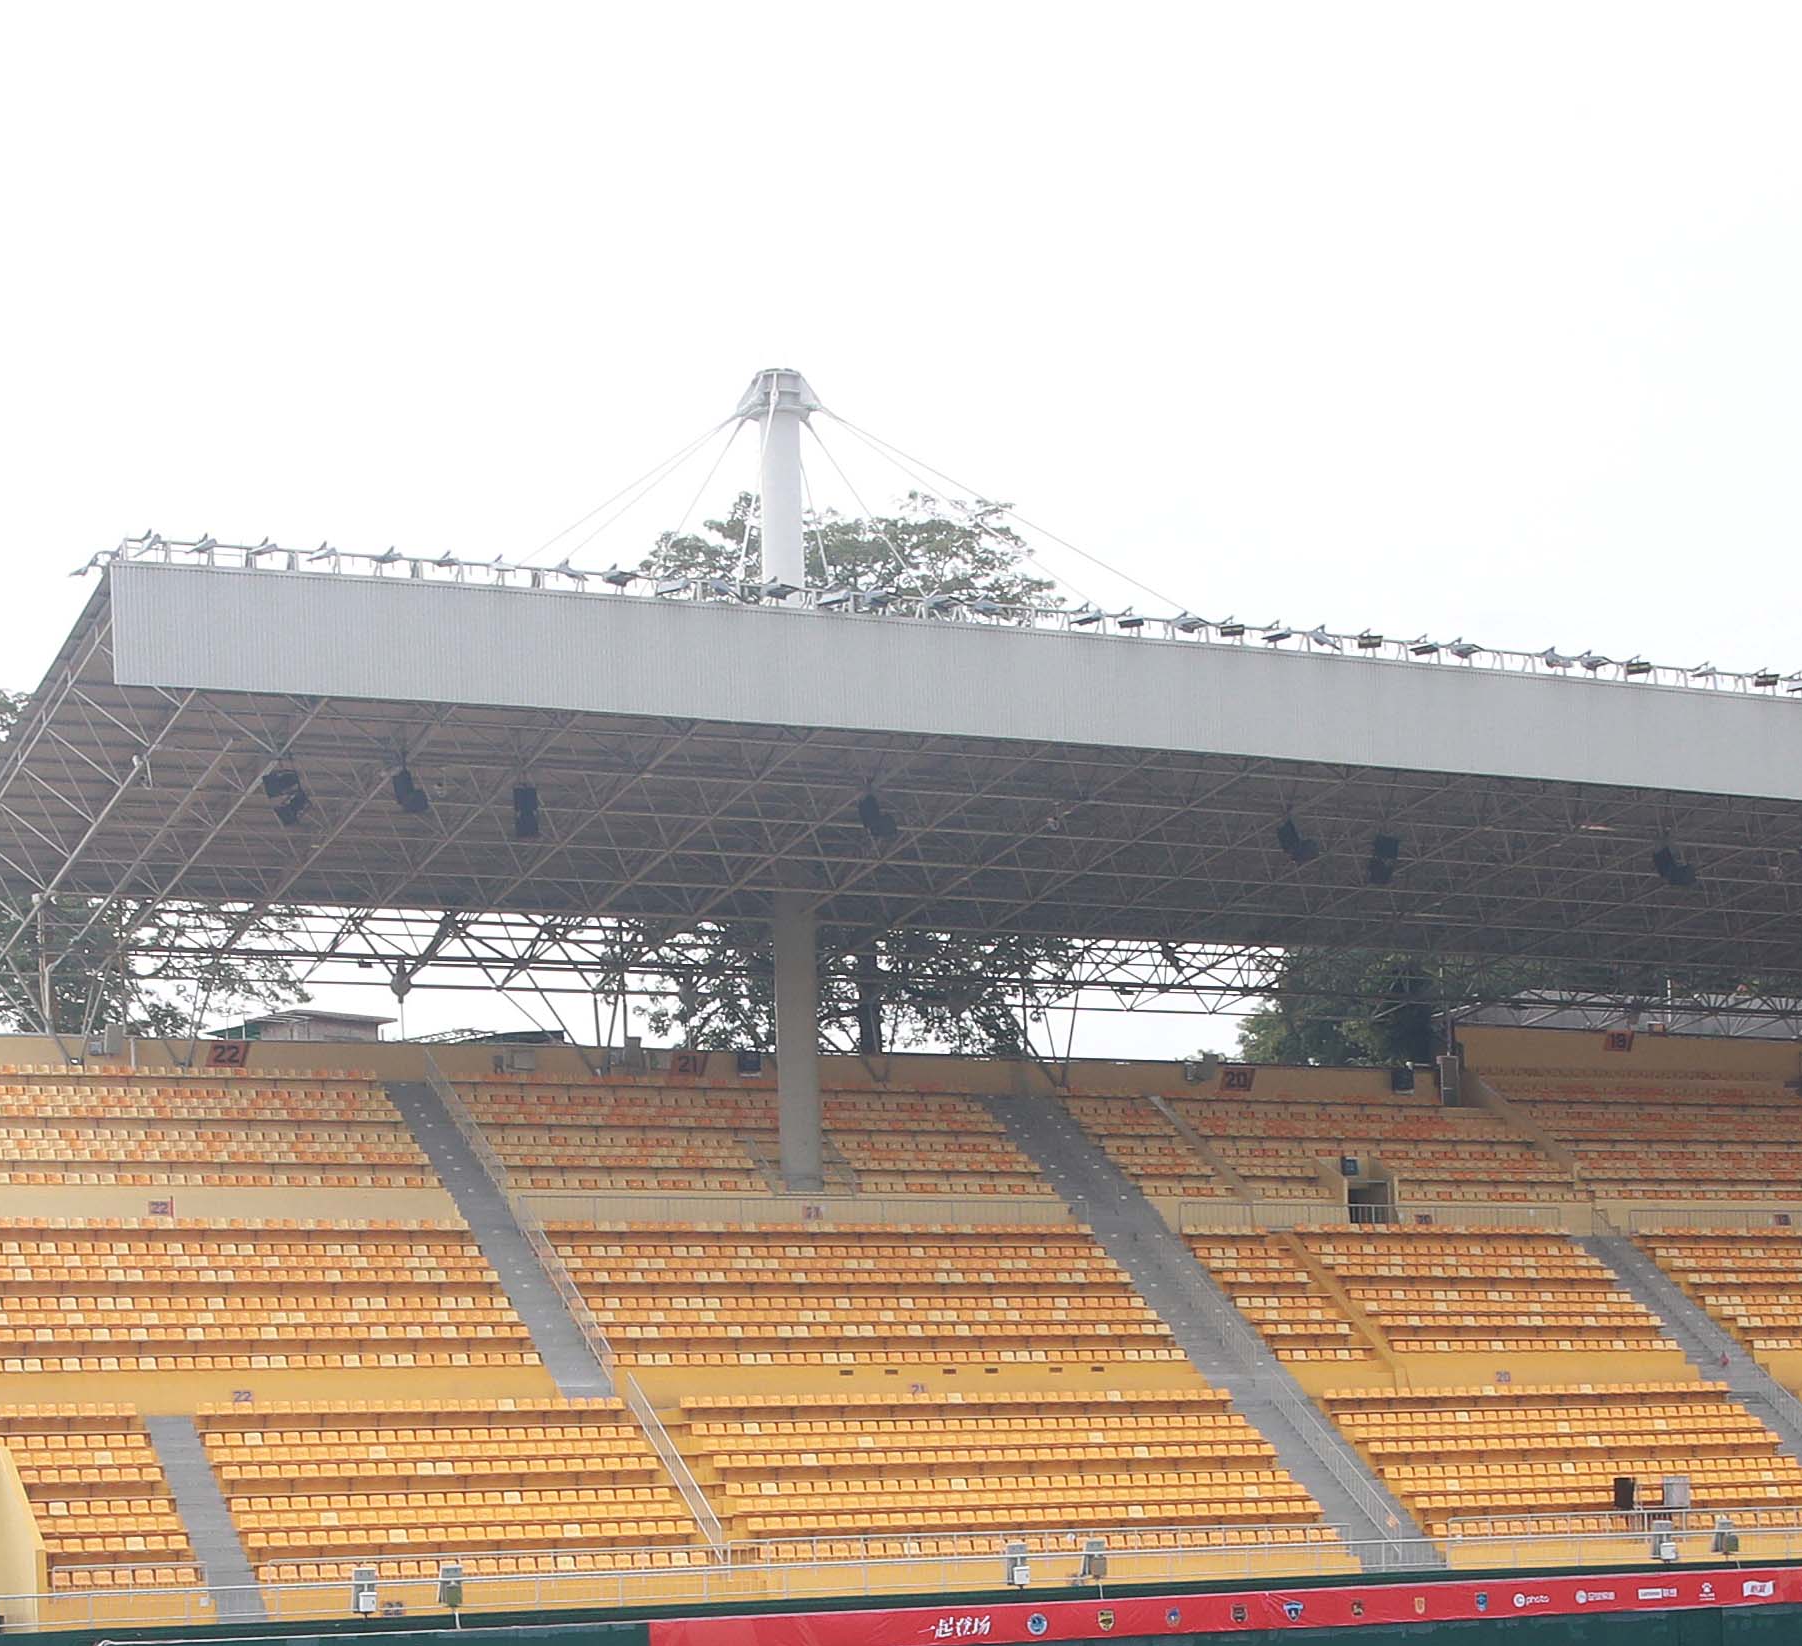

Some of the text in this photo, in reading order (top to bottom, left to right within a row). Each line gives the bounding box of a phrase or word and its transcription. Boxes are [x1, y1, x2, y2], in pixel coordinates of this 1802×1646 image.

[213, 1045, 240, 1064] 22
[678, 1056, 697, 1073] 21
[1226, 1071, 1248, 1088] 20
[150, 1201, 170, 1215] 22
[1495, 1371, 1512, 1383] 20
[233, 1391, 253, 1403] 22
